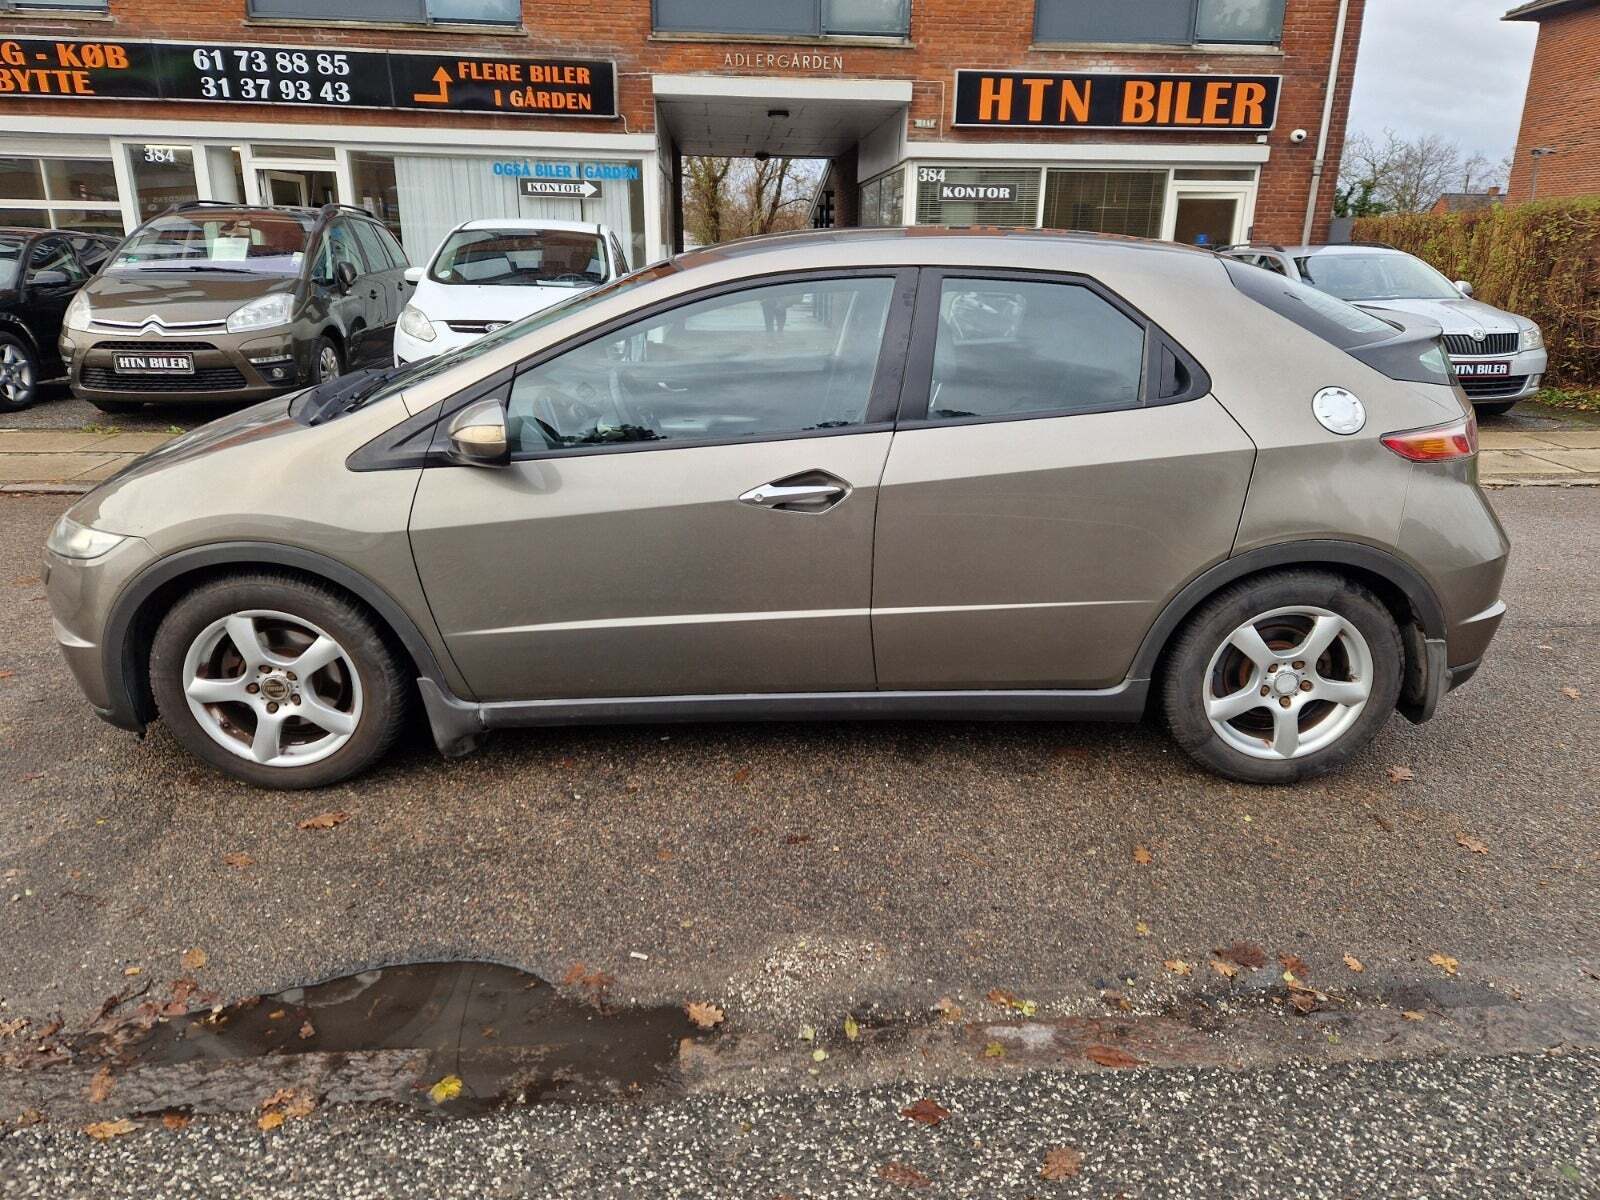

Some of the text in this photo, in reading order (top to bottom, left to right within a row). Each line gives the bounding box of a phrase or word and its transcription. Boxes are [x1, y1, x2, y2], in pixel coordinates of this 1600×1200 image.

[0, 41, 26, 66] G
[56, 43, 129, 69] KØB
[193, 49, 350, 76] 61 73 88 85
[0, 68, 95, 94] BYTTE
[457, 61, 591, 85] FLERE BILER
[201, 77, 350, 102] 31 37 93 43
[494, 86, 592, 110] I GÅRDEN
[978, 77, 1267, 125] HTN BILER
[144, 147, 176, 162] 384
[493, 159, 531, 177] OGSÅ
[535, 163, 572, 178] BILER
[584, 163, 640, 180] GÅRDEN
[919, 168, 945, 182] 384
[530, 183, 581, 193] KONTOR
[943, 186, 1010, 199] KONTOR
[120, 357, 189, 369] HTN BILER
[1477, 364, 1507, 375] BILER
